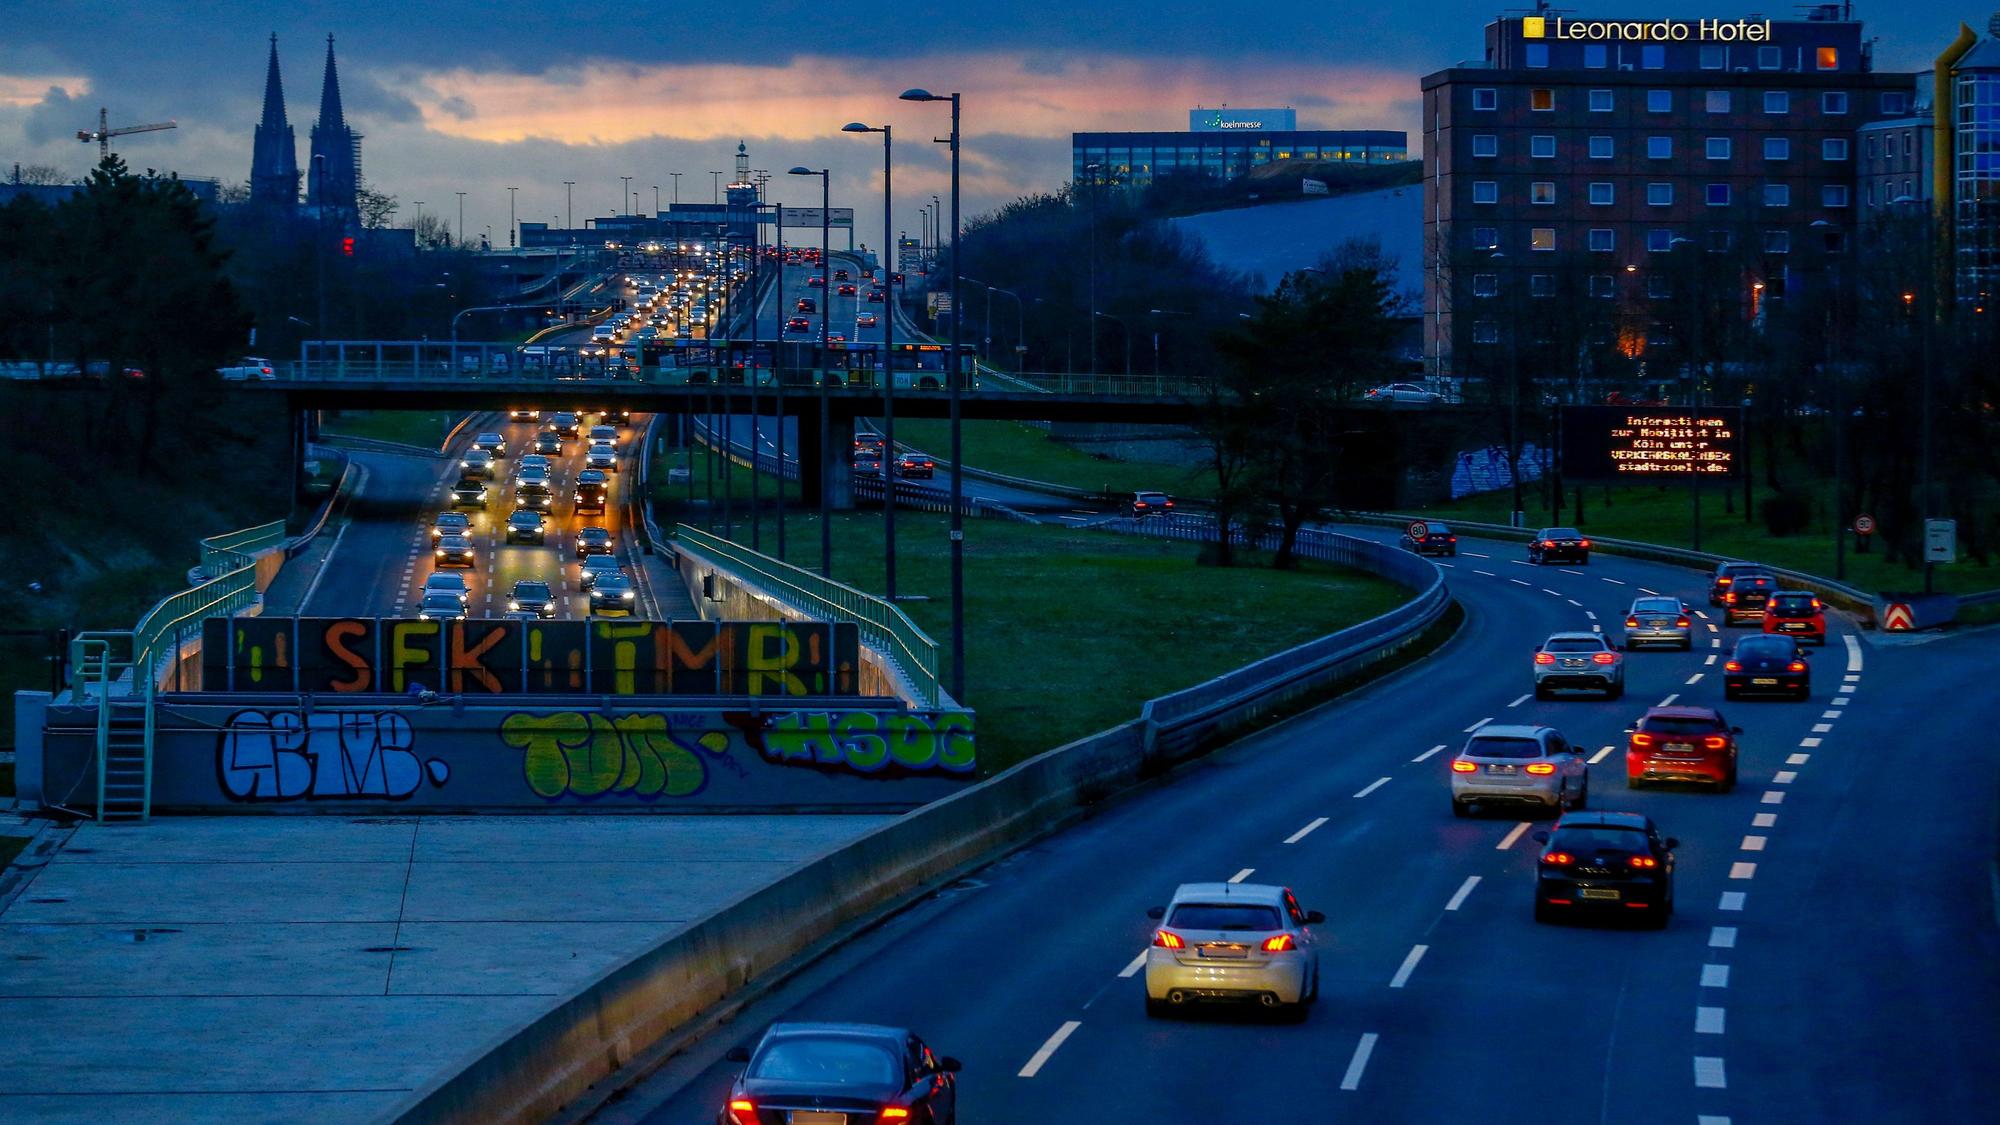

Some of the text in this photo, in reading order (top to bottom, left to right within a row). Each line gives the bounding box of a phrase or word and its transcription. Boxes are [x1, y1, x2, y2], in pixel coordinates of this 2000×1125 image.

[1556, 17, 1771, 41] Leonardo Hotel
[1220, 120, 1262, 129] koelnmesse
[1627, 416, 1723, 426] Informatinen
[1611, 430, 1634, 438] zur
[1715, 429, 1731, 438] in
[1633, 440, 1709, 449] Köln untr
[324, 621, 507, 693] SFK
